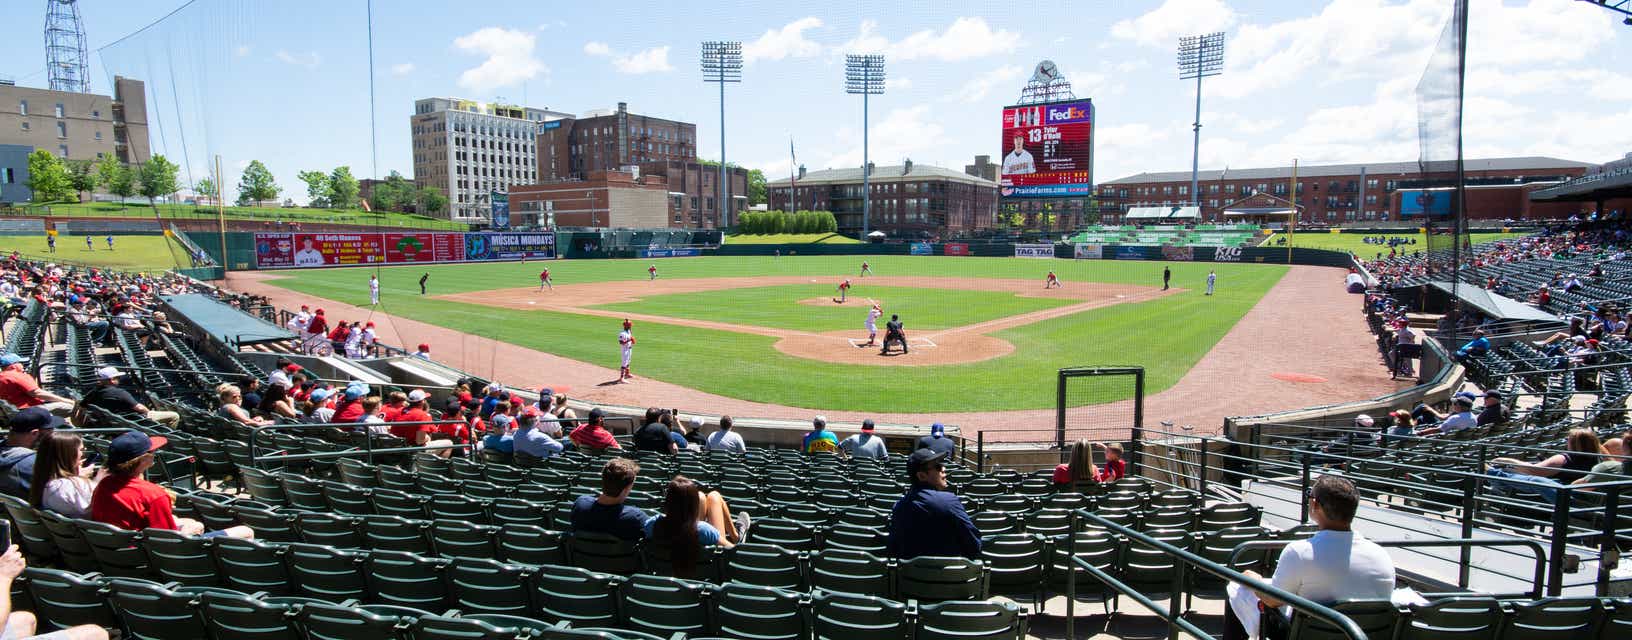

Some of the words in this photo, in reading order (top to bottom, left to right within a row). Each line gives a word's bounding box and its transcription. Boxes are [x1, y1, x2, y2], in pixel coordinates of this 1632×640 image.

[1049, 107, 1085, 120] FedEx
[1028, 129, 1041, 142] 13
[521, 235, 553, 246] MONDAYS
